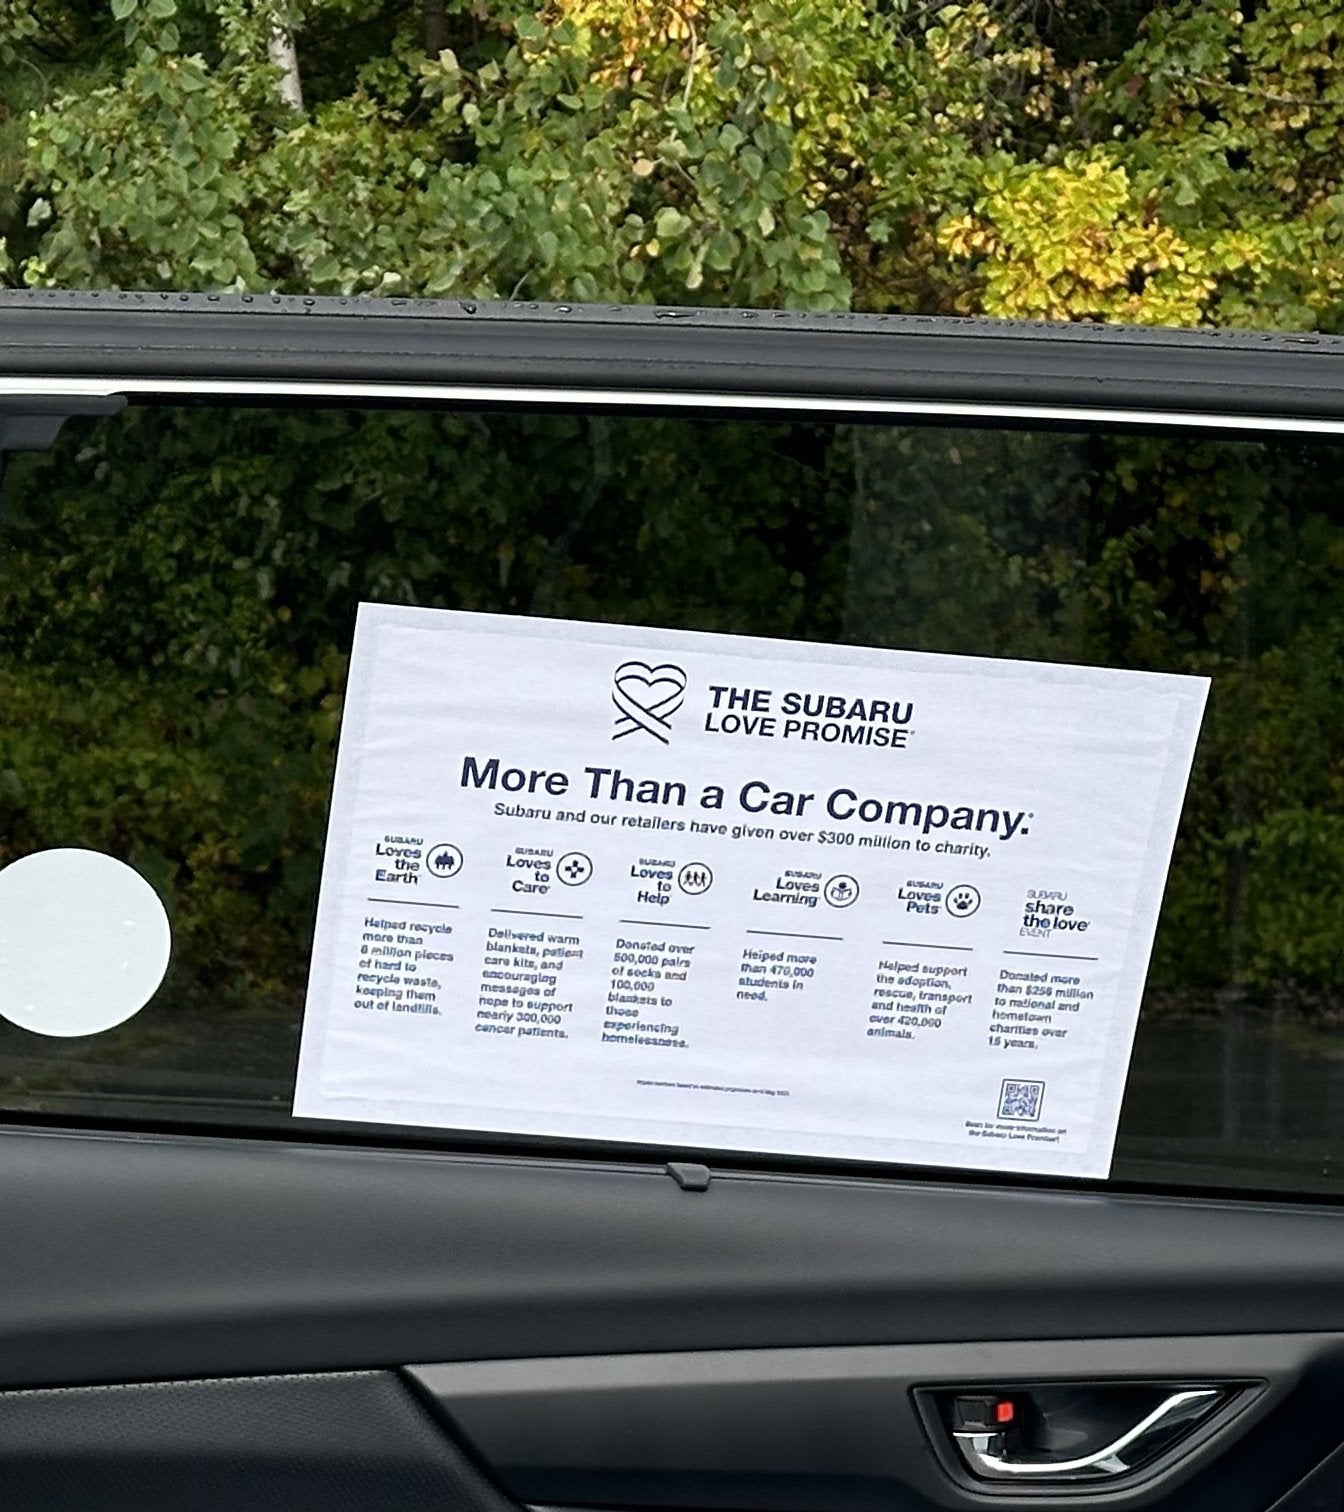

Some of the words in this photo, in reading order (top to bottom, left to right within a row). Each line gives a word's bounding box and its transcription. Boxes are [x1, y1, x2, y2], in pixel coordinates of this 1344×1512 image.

[708, 685, 773, 713] THE
[780, 692, 914, 725] SUBARU
[704, 712, 777, 738] LOVE
[782, 719, 910, 749] PROMISE
[460, 755, 570, 796] More
[584, 766, 687, 807] Than
[699, 785, 725, 810] a
[738, 780, 815, 817] Car
[826, 788, 1029, 841] Company.
[493, 802, 552, 820] Subaru
[555, 809, 587, 823] and
[589, 813, 618, 826] our
[621, 815, 686, 832] retailers
[689, 819, 728, 836] have
[731, 823, 775, 840] given
[778, 829, 815, 843] over
[816, 830, 855, 846] $300
[857, 834, 911, 851] million
[915, 839, 931, 853] to
[934, 840, 991, 860] charity.
[375, 842, 422, 860] Loves
[394, 858, 421, 872] the
[505, 854, 552, 871] Loves
[374, 868, 419, 886] Earth
[534, 870, 550, 883] to
[630, 864, 674, 881] Loves
[511, 879, 549, 895] Care
[656, 880, 672, 893] to
[775, 876, 820, 893] Loves
[636, 890, 671, 907] Help
[752, 887, 820, 908] Learning
[897, 887, 942, 903] Loves
[905, 900, 941, 915] Pets
[1024, 899, 1075, 917] share
[364, 916, 408, 932] Helped
[409, 922, 453, 936] recycle
[1022, 913, 1051, 929] the
[1052, 915, 1089, 932] love
[362, 932, 394, 944] more
[396, 934, 424, 946] than
[487, 927, 546, 943] Delivered
[547, 934, 580, 946] warm
[370, 945, 412, 959] million
[414, 948, 455, 963] pieces
[541, 946, 585, 960] patient
[615, 938, 667, 953] Donated
[667, 944, 696, 955] over
[358, 957, 373, 969] of
[374, 958, 403, 972] hard
[404, 962, 418, 973] to
[483, 956, 511, 967] care
[539, 960, 564, 972] and
[613, 951, 659, 966] 500,000
[660, 956, 692, 969] pairs
[742, 948, 785, 963] Helped
[785, 954, 818, 965] more
[611, 965, 626, 977] of
[626, 967, 662, 979] socks
[664, 970, 688, 982] and
[740, 962, 768, 975] than
[877, 960, 920, 975] Helped
[921, 964, 969, 978] support
[999, 968, 1049, 984] Donated
[1049, 975, 1081, 986] more
[356, 972, 401, 986] recycle
[481, 969, 557, 987] encouraging
[610, 978, 656, 993] 100,000
[738, 976, 790, 990] students
[792, 979, 804, 991] in
[876, 972, 896, 985] the
[355, 984, 404, 1001] keeping
[405, 988, 437, 1002] them
[480, 983, 541, 998] messages
[543, 986, 557, 998] of
[607, 990, 658, 1006] blankets
[660, 996, 673, 1008] to
[918, 990, 973, 1005] transport
[996, 982, 1023, 995] than
[1054, 987, 1095, 1000] million
[353, 999, 375, 1010] out
[376, 1000, 390, 1012] of
[478, 996, 510, 1009] hope
[511, 997, 525, 1009] to
[526, 1000, 574, 1014] support
[605, 1004, 640, 1018] those
[870, 1000, 895, 1012] and
[895, 1001, 933, 1015] health
[934, 1004, 948, 1016] of
[994, 996, 1007, 1007] to
[1008, 997, 1057, 1010] national
[1056, 1001, 1081, 1013] and
[476, 1009, 515, 1024] nearly
[868, 1014, 896, 1025] over
[991, 1008, 1053, 1024] hometown
[474, 1023, 517, 1035] cancer
[603, 1020, 680, 1037] experiencing
[988, 1022, 1040, 1037] charities
[1040, 1028, 1069, 1038] over
[987, 1035, 1002, 1047] 15
